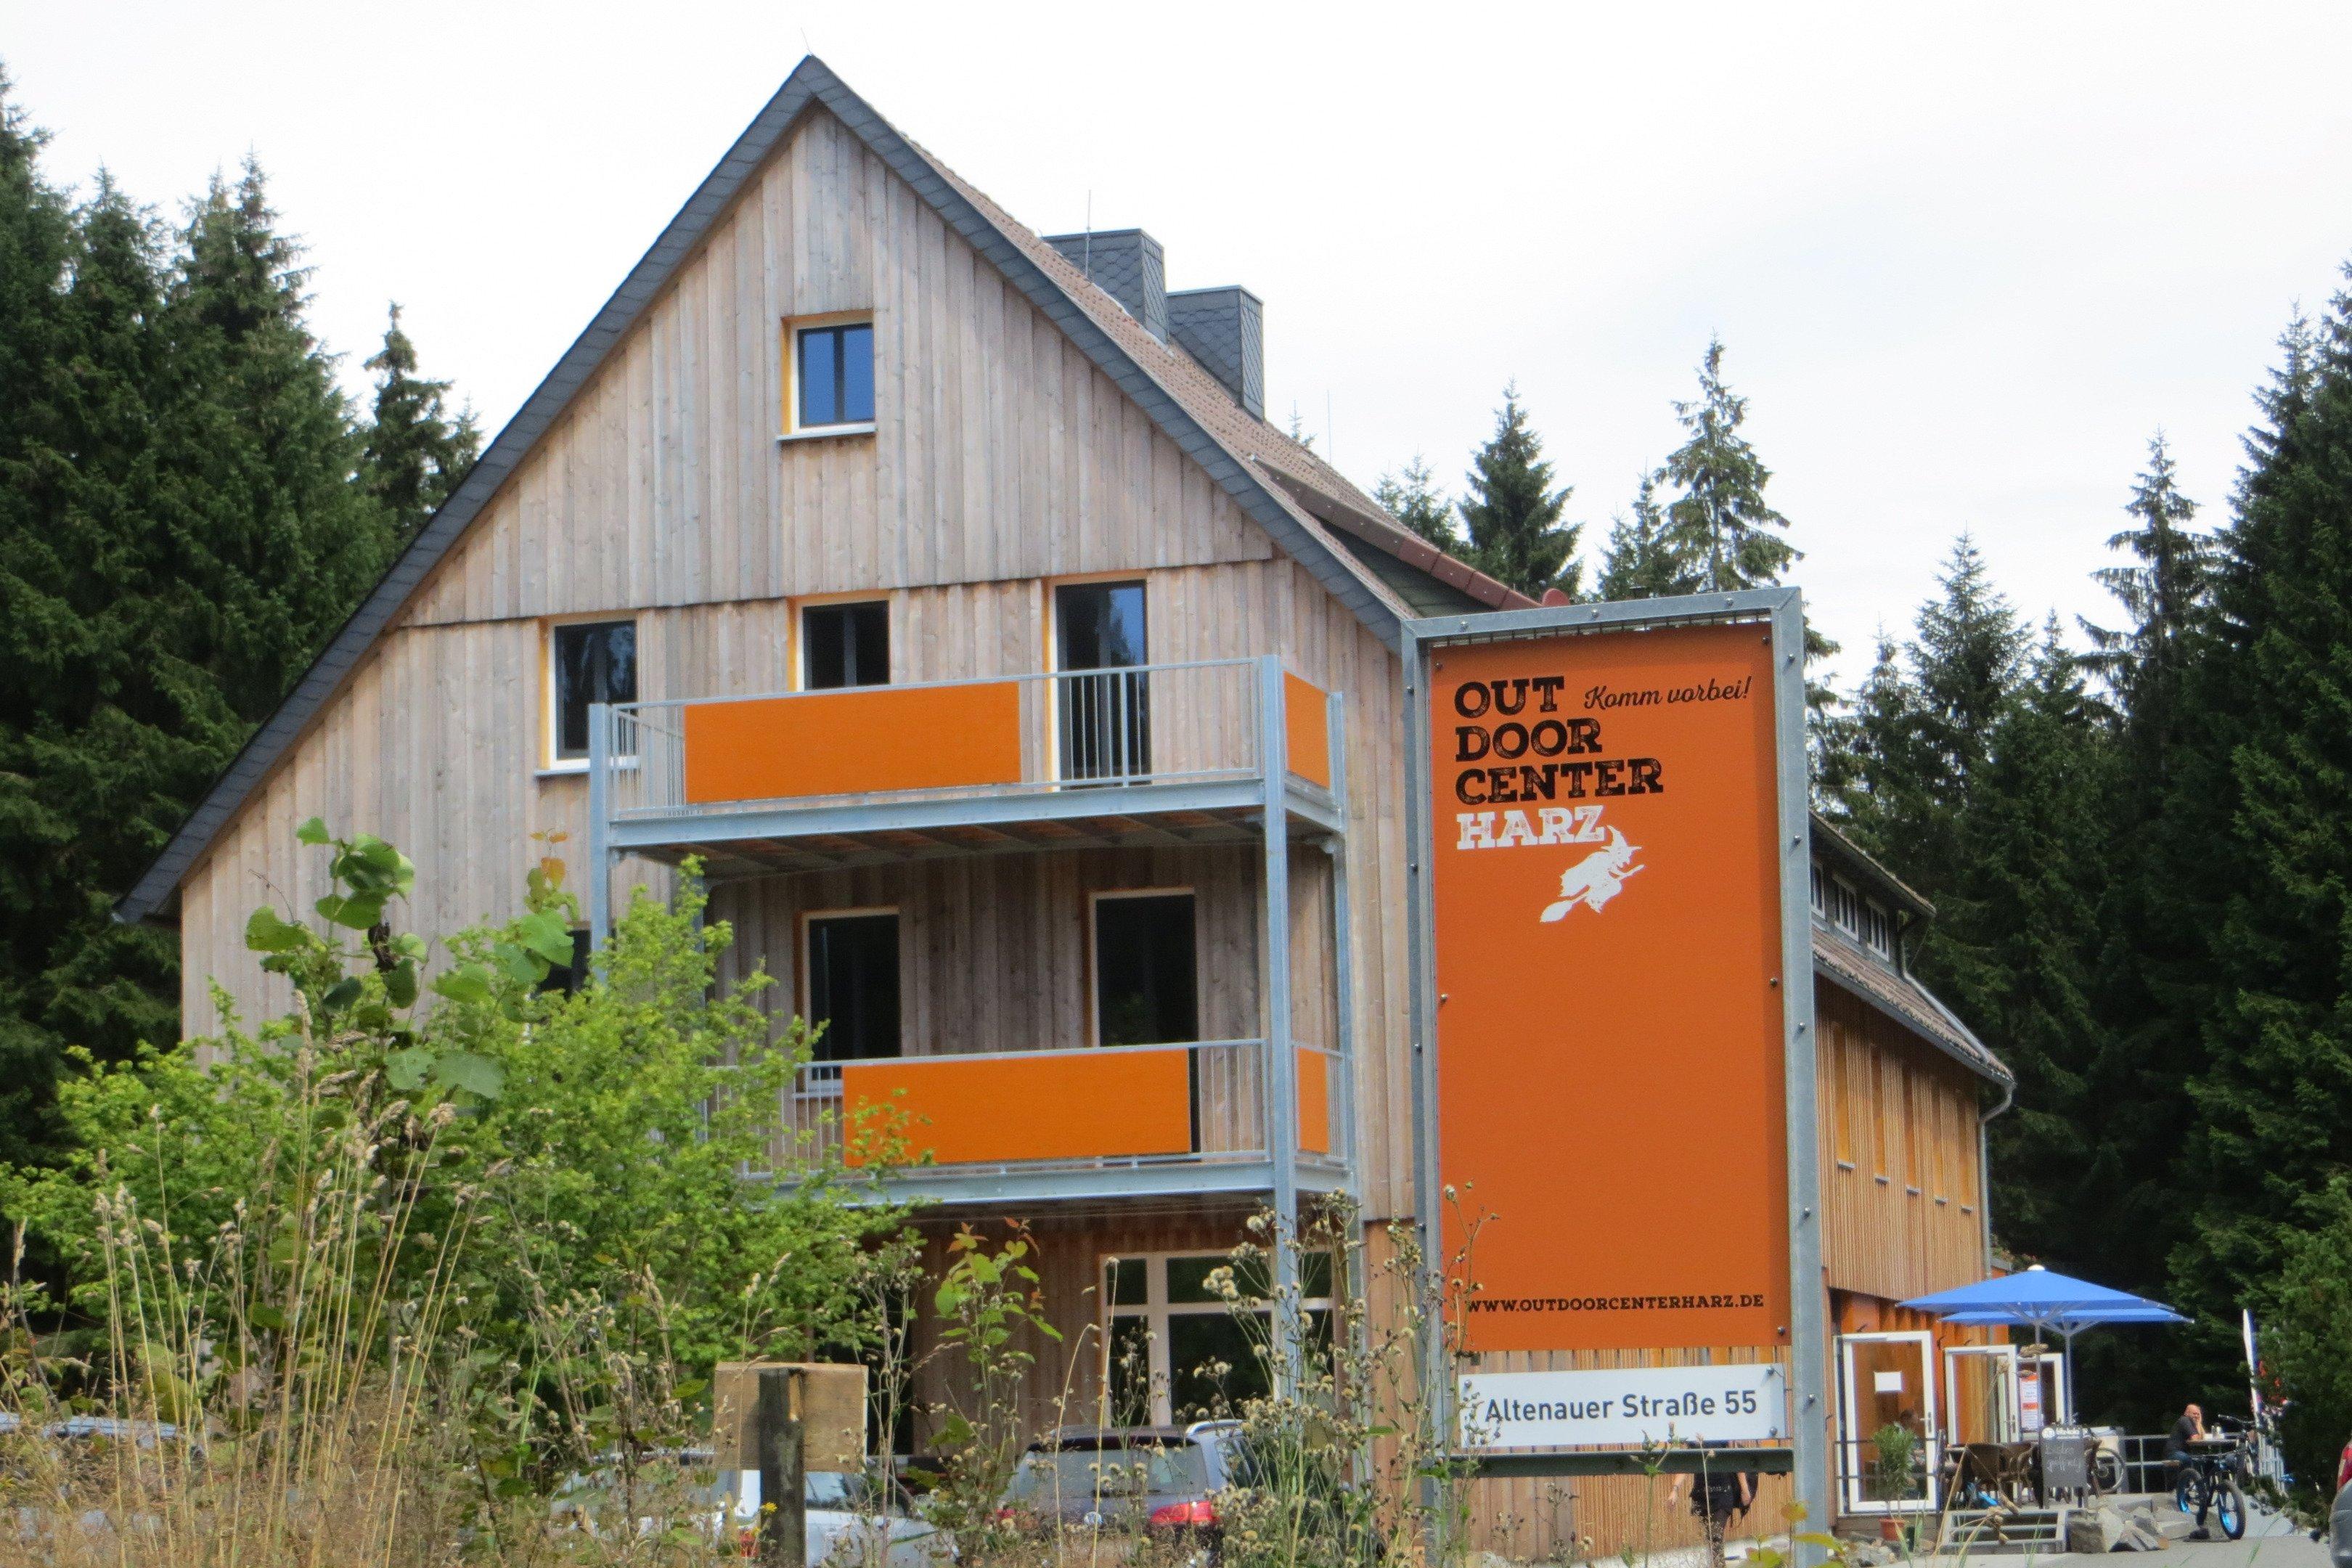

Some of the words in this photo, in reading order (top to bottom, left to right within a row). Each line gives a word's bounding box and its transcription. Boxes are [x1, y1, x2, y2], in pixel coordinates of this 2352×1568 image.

[1455, 676, 1564, 719] OUT
[1584, 685, 1662, 710] Komm
[1667, 676, 1752, 704] vorbei!
[1455, 718, 1603, 761] DOOR
[1455, 758, 1664, 805] CENTER
[1456, 805, 1605, 850] HARZ
[1466, 1294, 1764, 1312] WWW.OUTDOORCENTERHARZ.DE
[1485, 1397, 1613, 1422] Altenauer
[1622, 1391, 1715, 1418] Straße
[1725, 1389, 1757, 1414] 55
